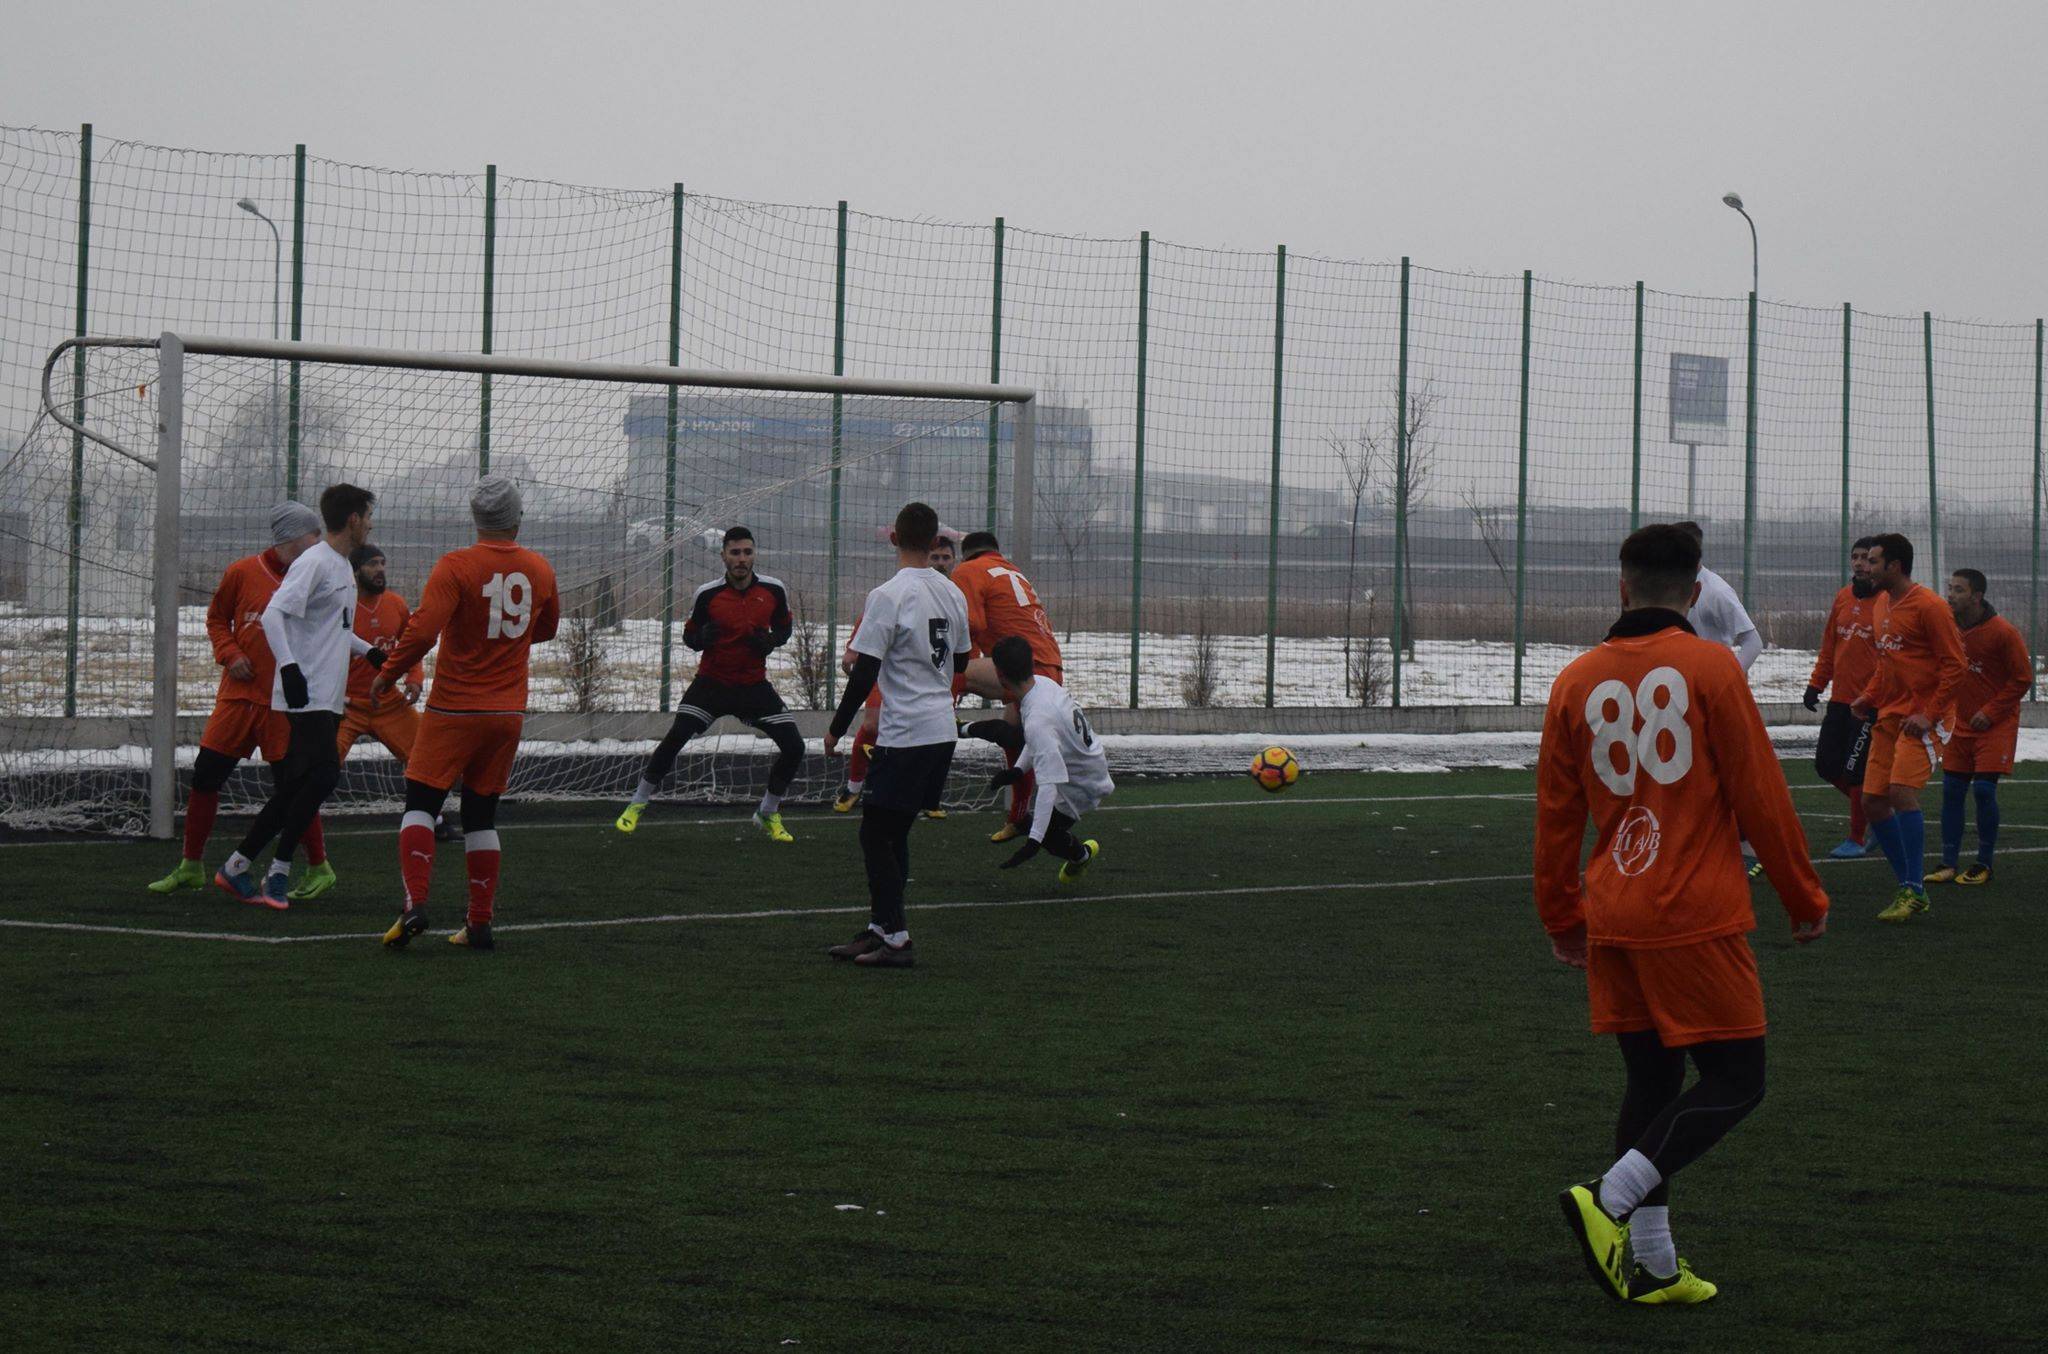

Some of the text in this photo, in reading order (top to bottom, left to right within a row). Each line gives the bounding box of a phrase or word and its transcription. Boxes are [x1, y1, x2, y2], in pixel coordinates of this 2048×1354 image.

[692, 419, 756, 432] HYUNDAI
[921, 425, 985, 438] HYUNDAI
[482, 572, 532, 639] 19
[928, 617, 949, 671] 5
[1585, 666, 1693, 796] 88
[1846, 721, 1872, 771] GIVOVA
